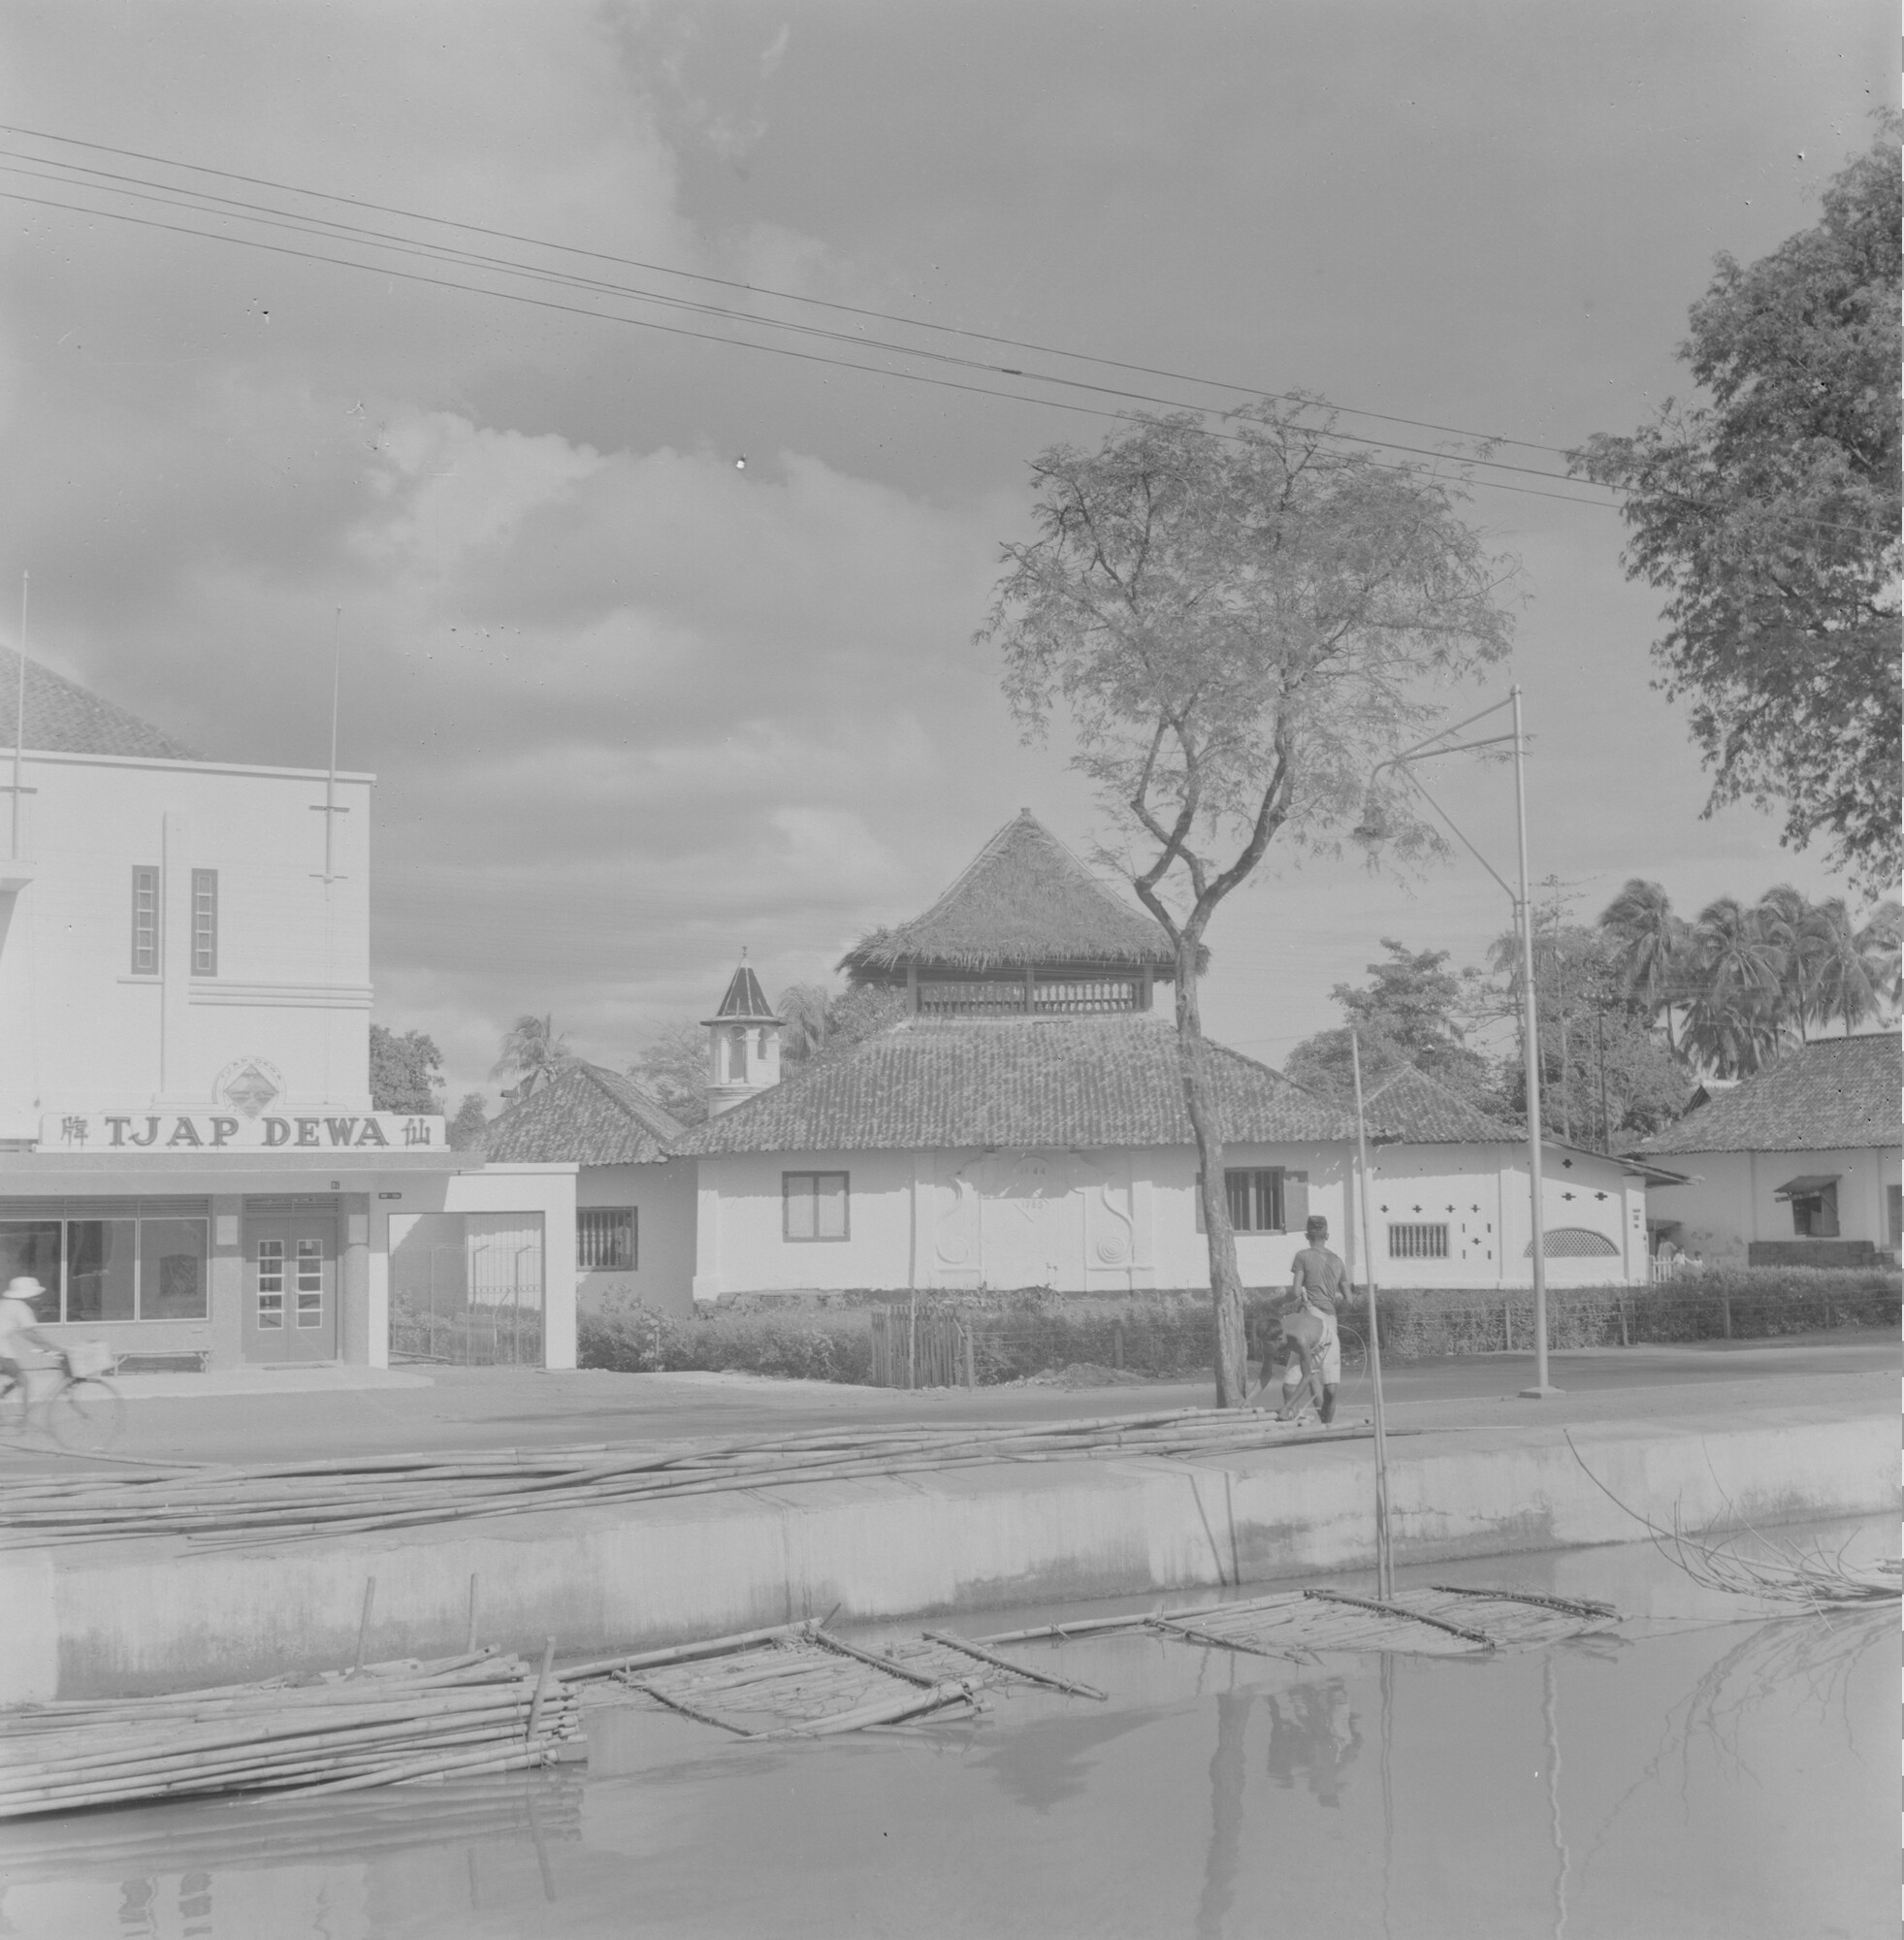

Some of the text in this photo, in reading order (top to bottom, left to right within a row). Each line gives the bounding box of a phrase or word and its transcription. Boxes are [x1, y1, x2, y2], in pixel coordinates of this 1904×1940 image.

[60, 1116, 88, 1147] 牌
[105, 1116, 390, 1146] TJAP DEWA
[401, 1117, 431, 1146] 仙
